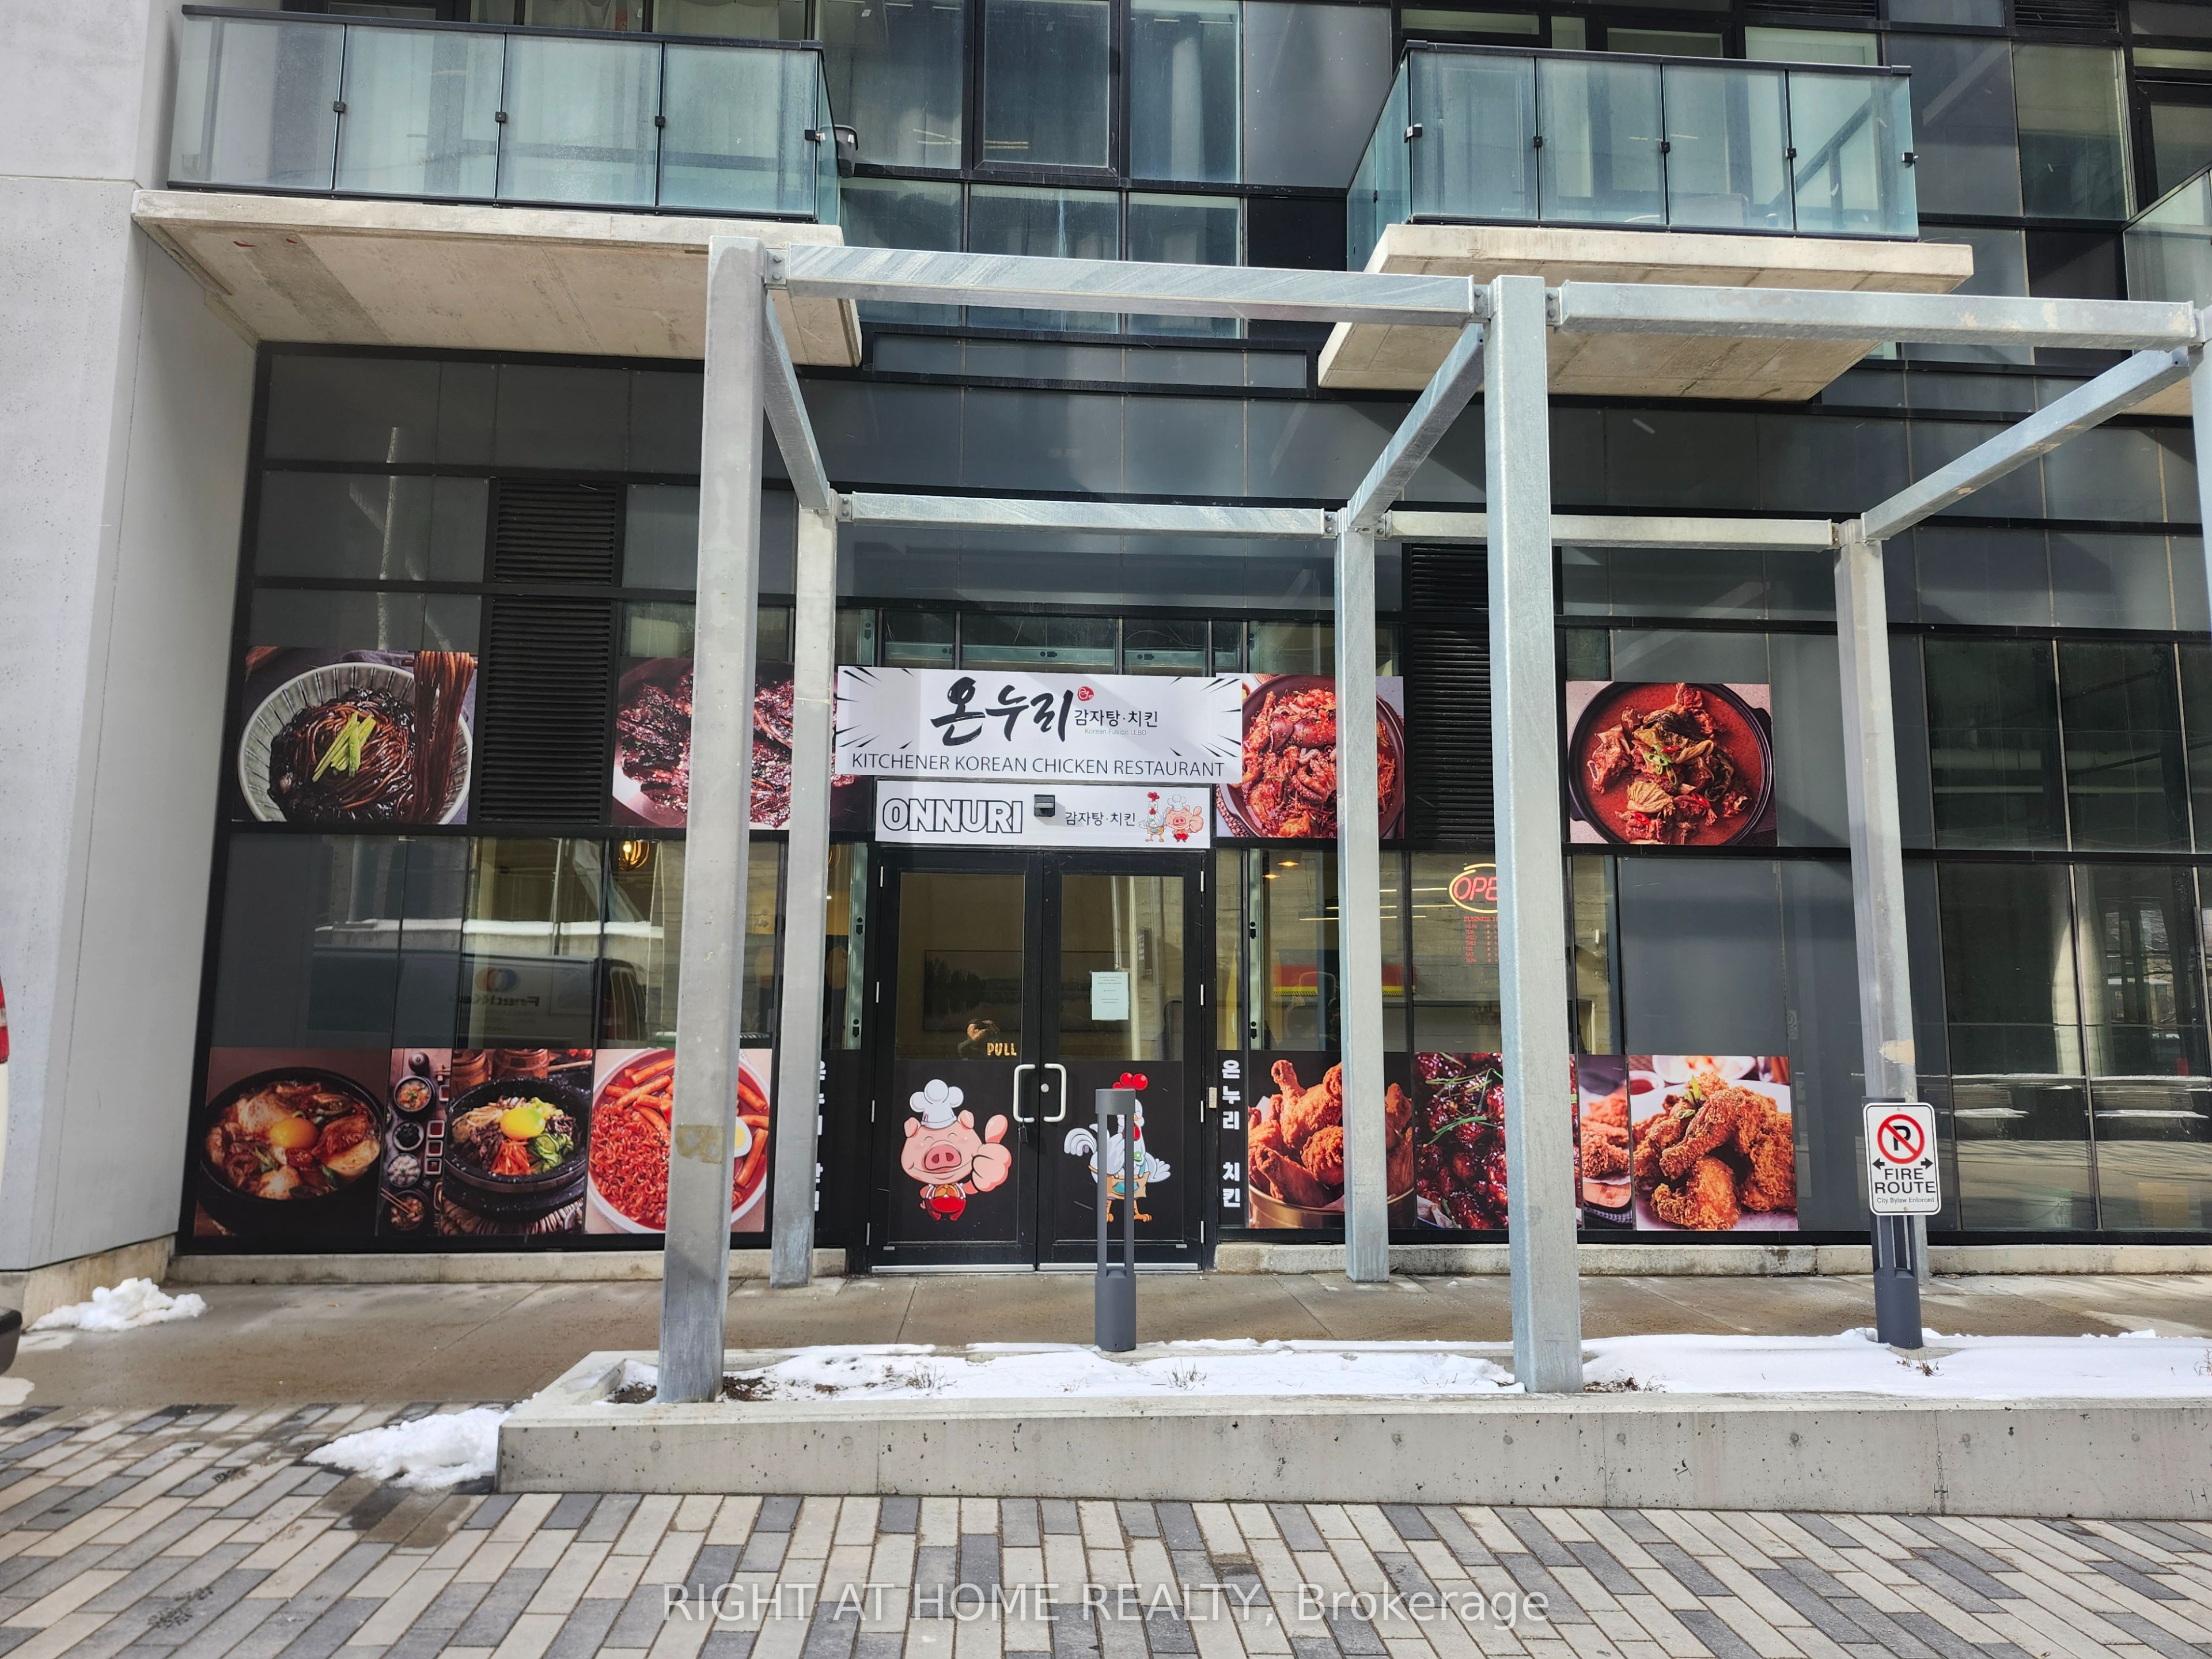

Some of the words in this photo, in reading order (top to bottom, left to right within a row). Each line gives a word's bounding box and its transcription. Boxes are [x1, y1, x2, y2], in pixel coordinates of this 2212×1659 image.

[930, 676, 1073, 746] 온누리
[853, 753, 949, 770] KITCHENER
[956, 756, 1027, 771] KOREAN
[1032, 758, 1108, 774] CHICKEN
[1114, 760, 1225, 777] RESTAURANT
[882, 798, 1023, 834] ONNURI
[1453, 876, 1498, 901] OPE
[987, 1042, 1017, 1056] PULL
[1222, 1060, 1240, 1130] 온누리
[1222, 1162, 1240, 1207] 치킨
[1884, 1168, 1924, 1180] FIRE
[1874, 1181, 1936, 1194] ROUTE
